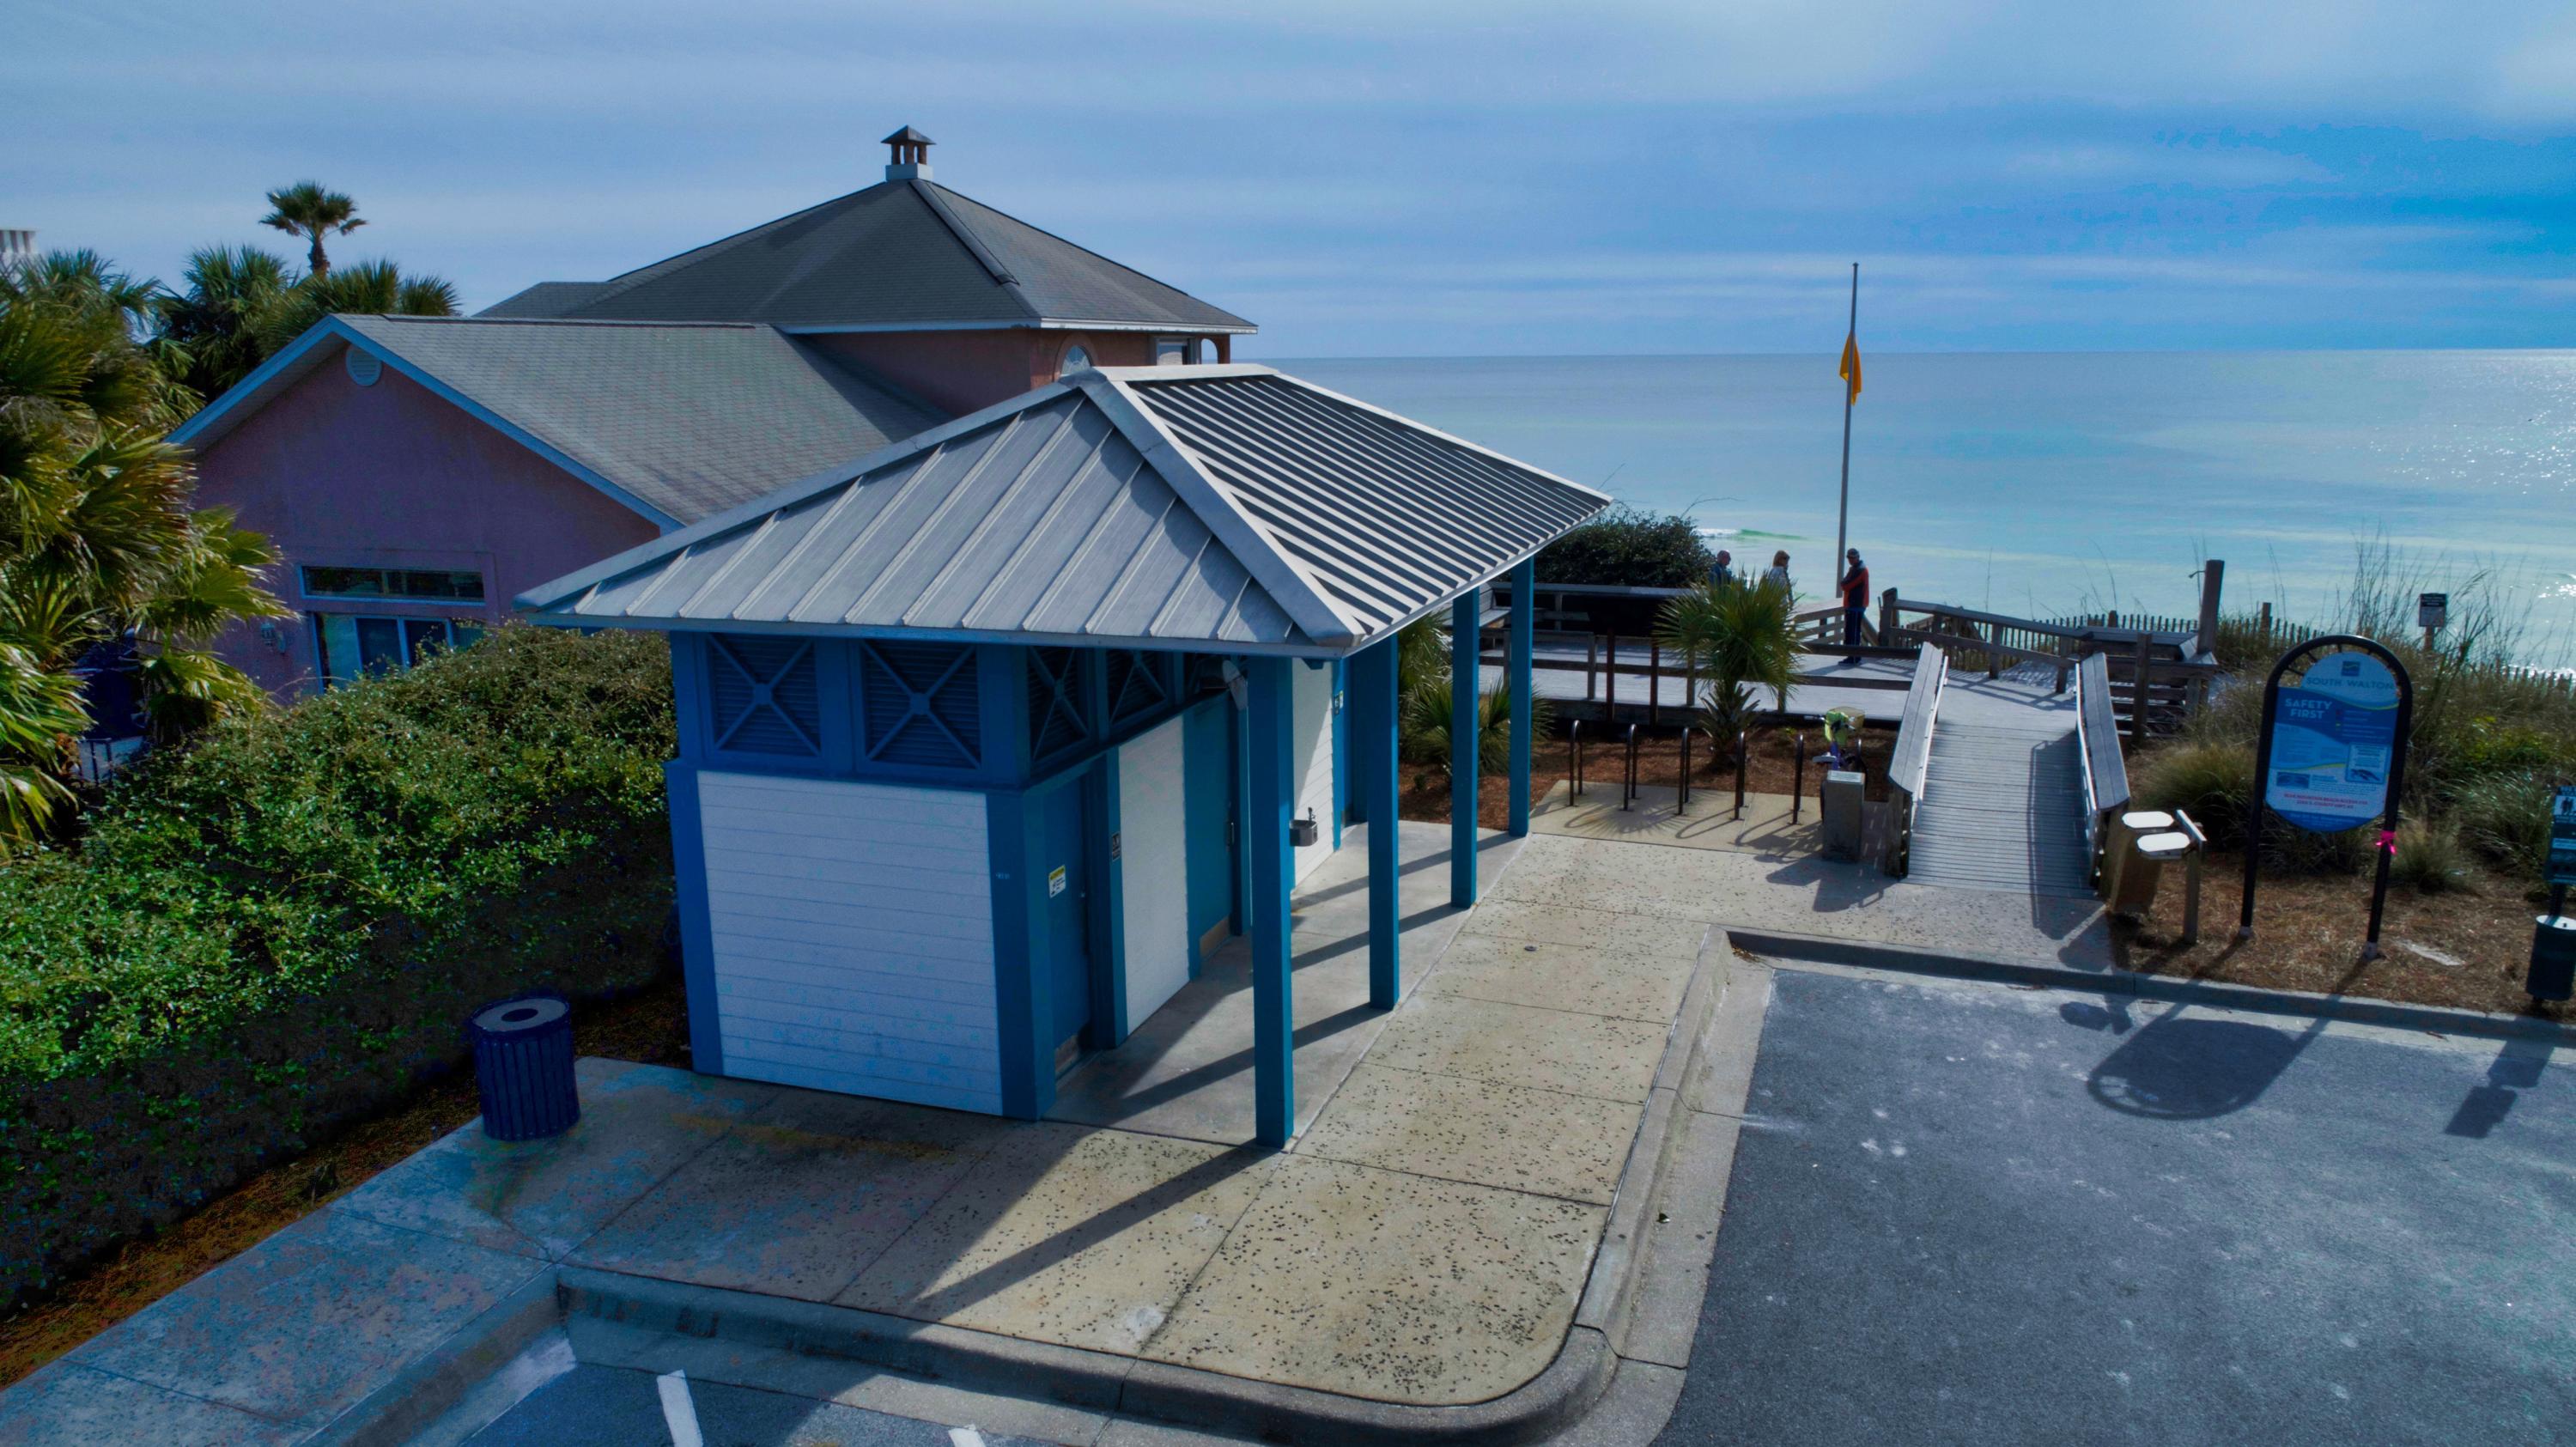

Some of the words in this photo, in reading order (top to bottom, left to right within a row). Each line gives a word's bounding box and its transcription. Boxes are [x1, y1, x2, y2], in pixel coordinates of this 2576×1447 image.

[2306, 677, 2342, 686] SOUTH
[2348, 679, 2394, 690] WALTON
[2285, 698, 2332, 710] SAFETY
[2290, 708, 2324, 719] FIRST
